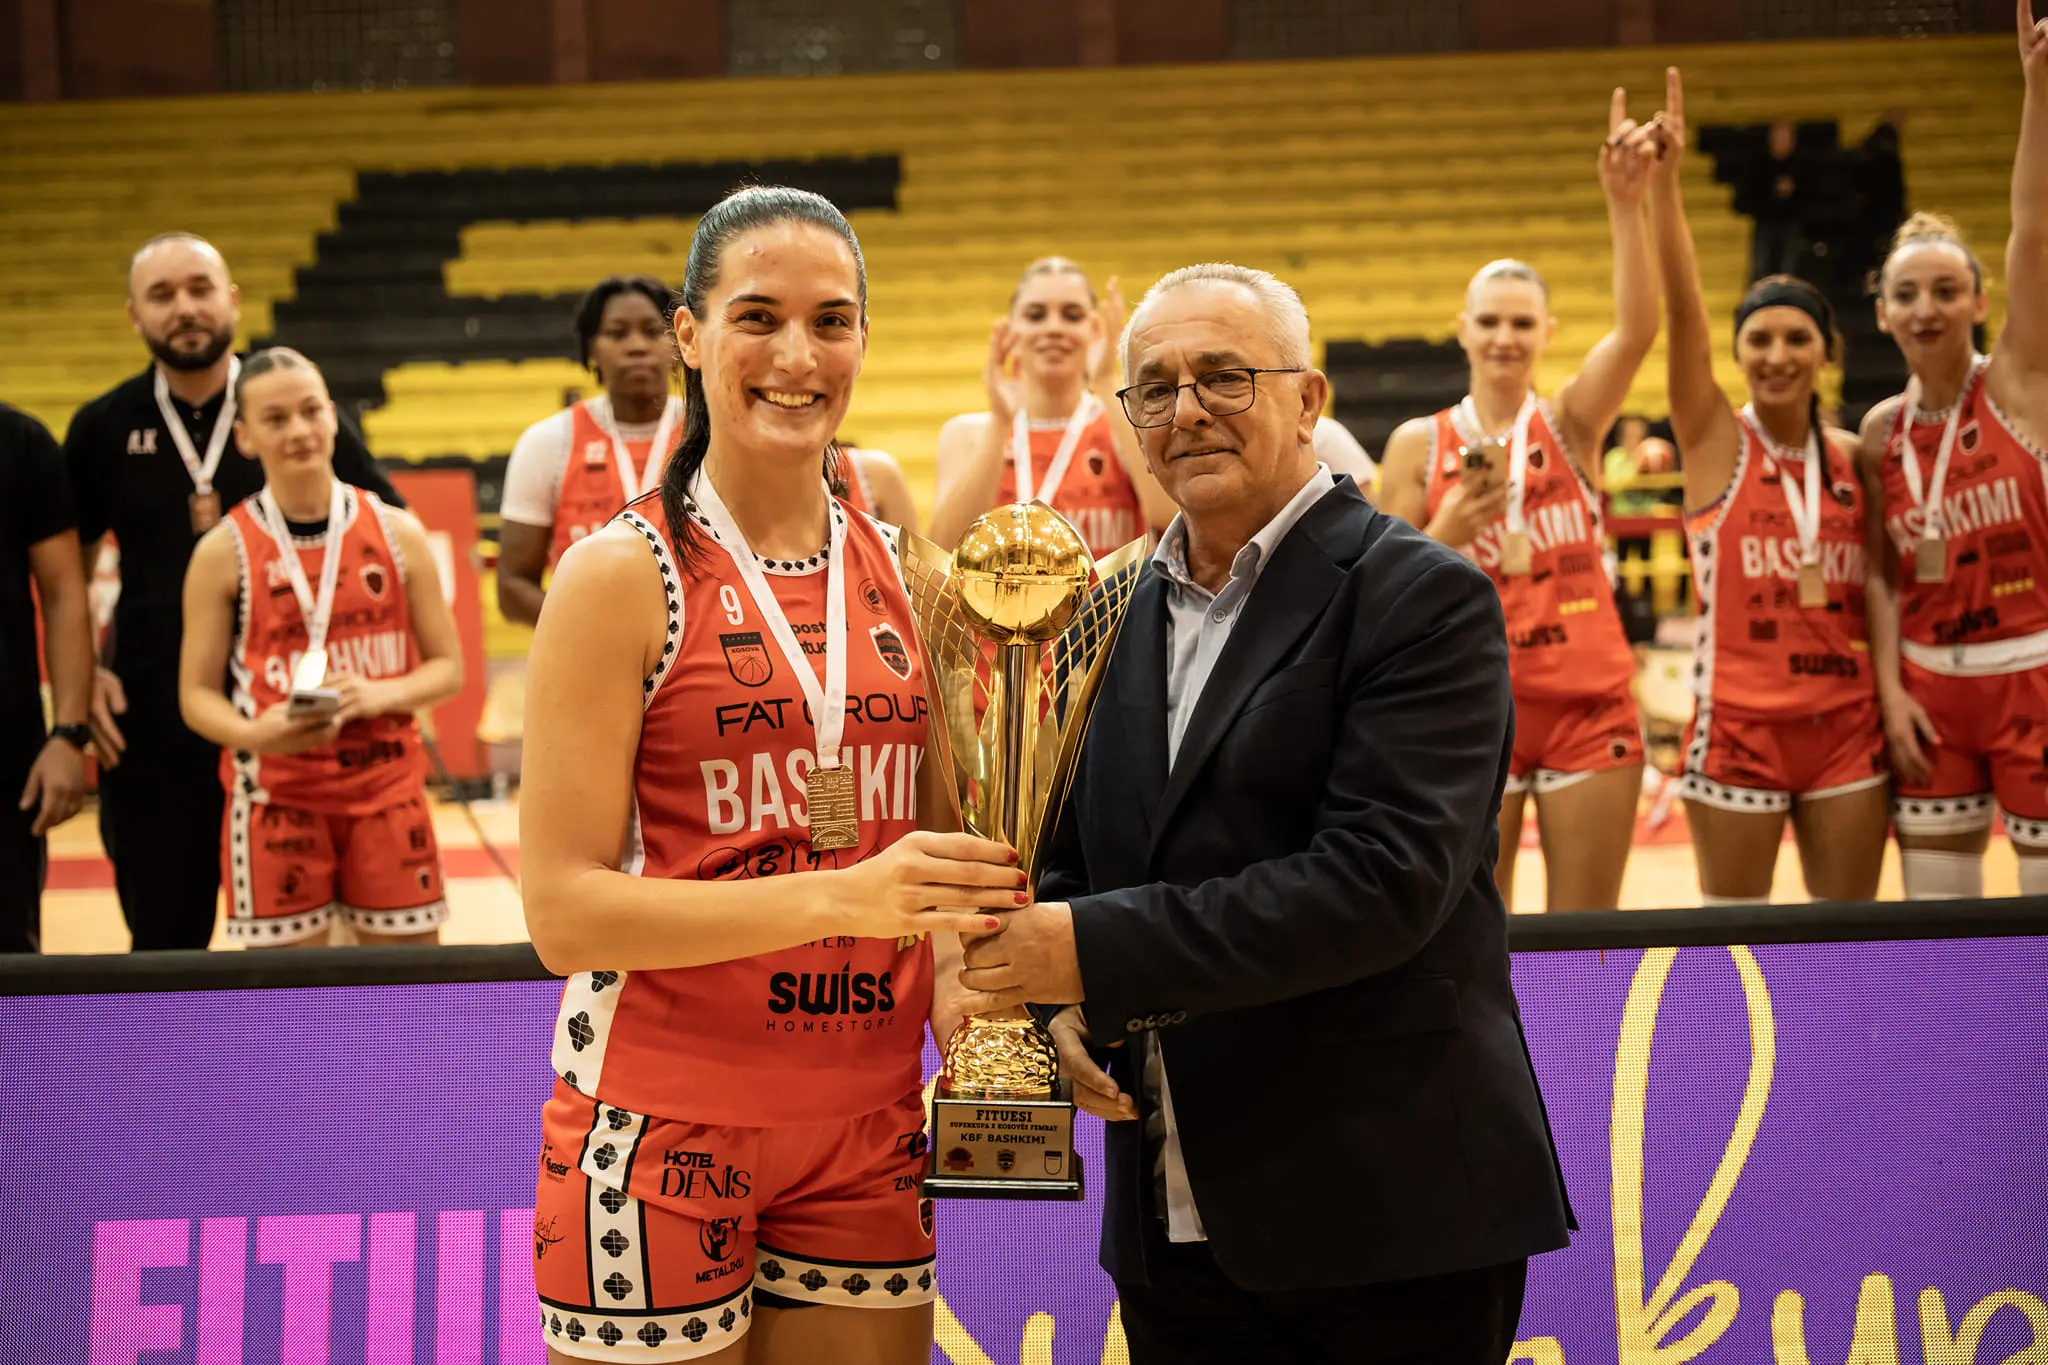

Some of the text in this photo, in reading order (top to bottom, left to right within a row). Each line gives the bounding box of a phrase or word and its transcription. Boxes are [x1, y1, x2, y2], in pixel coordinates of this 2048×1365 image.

[719, 584, 744, 626] 9
[731, 646, 760, 654] KOSOVA
[715, 697, 793, 737] FAT
[699, 743, 925, 835] BASKI
[766, 1015, 895, 1033] HOMESTORE
[976, 1109, 1032, 1123] FITUESI
[960, 1133, 1046, 1145] KBF BASHKIMI
[664, 1150, 716, 1169] HOTEL
[695, 1255, 745, 1284] METALIKU
